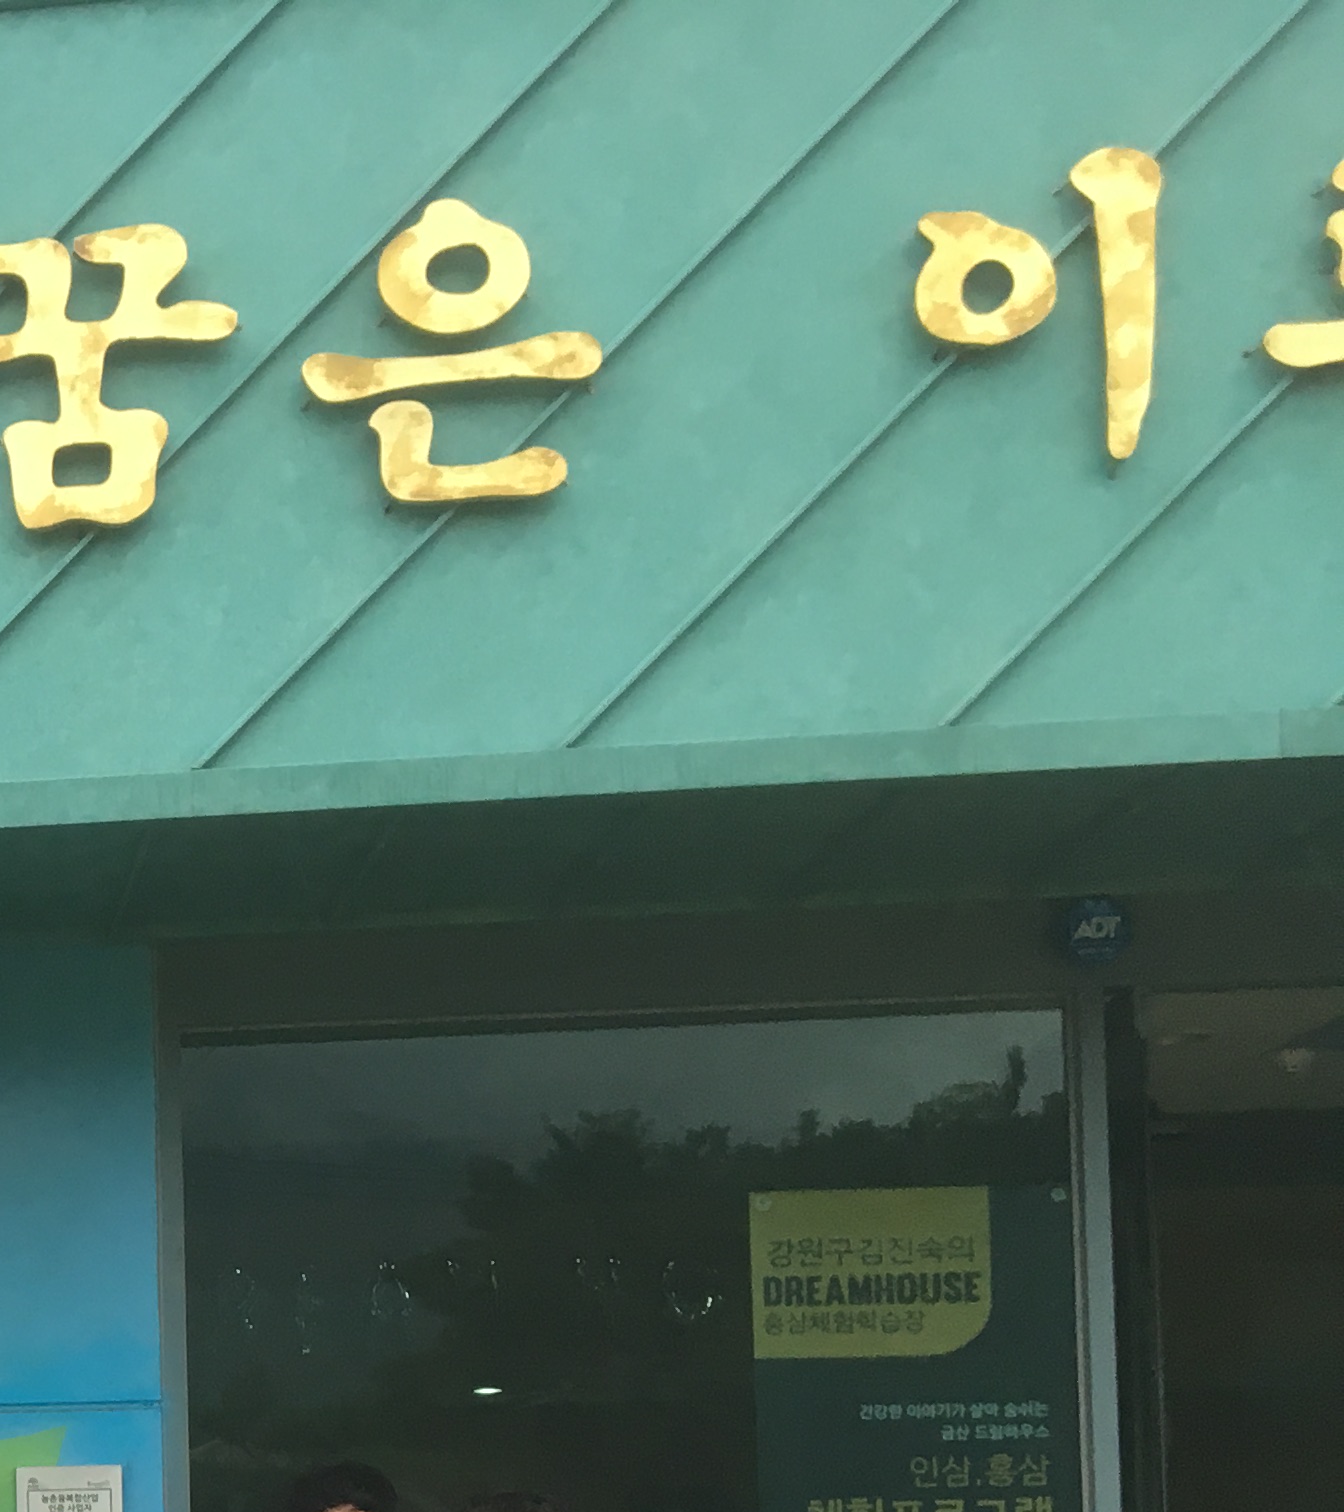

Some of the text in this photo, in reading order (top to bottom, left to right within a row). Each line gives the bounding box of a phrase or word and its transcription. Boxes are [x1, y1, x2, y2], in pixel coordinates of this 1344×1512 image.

[914, 145, 1344, 463] 이
[1073, 916, 1121, 939] ADT
[767, 1234, 976, 1268] 강원구김진숙의
[762, 1271, 983, 1308] DREAMHOUSE
